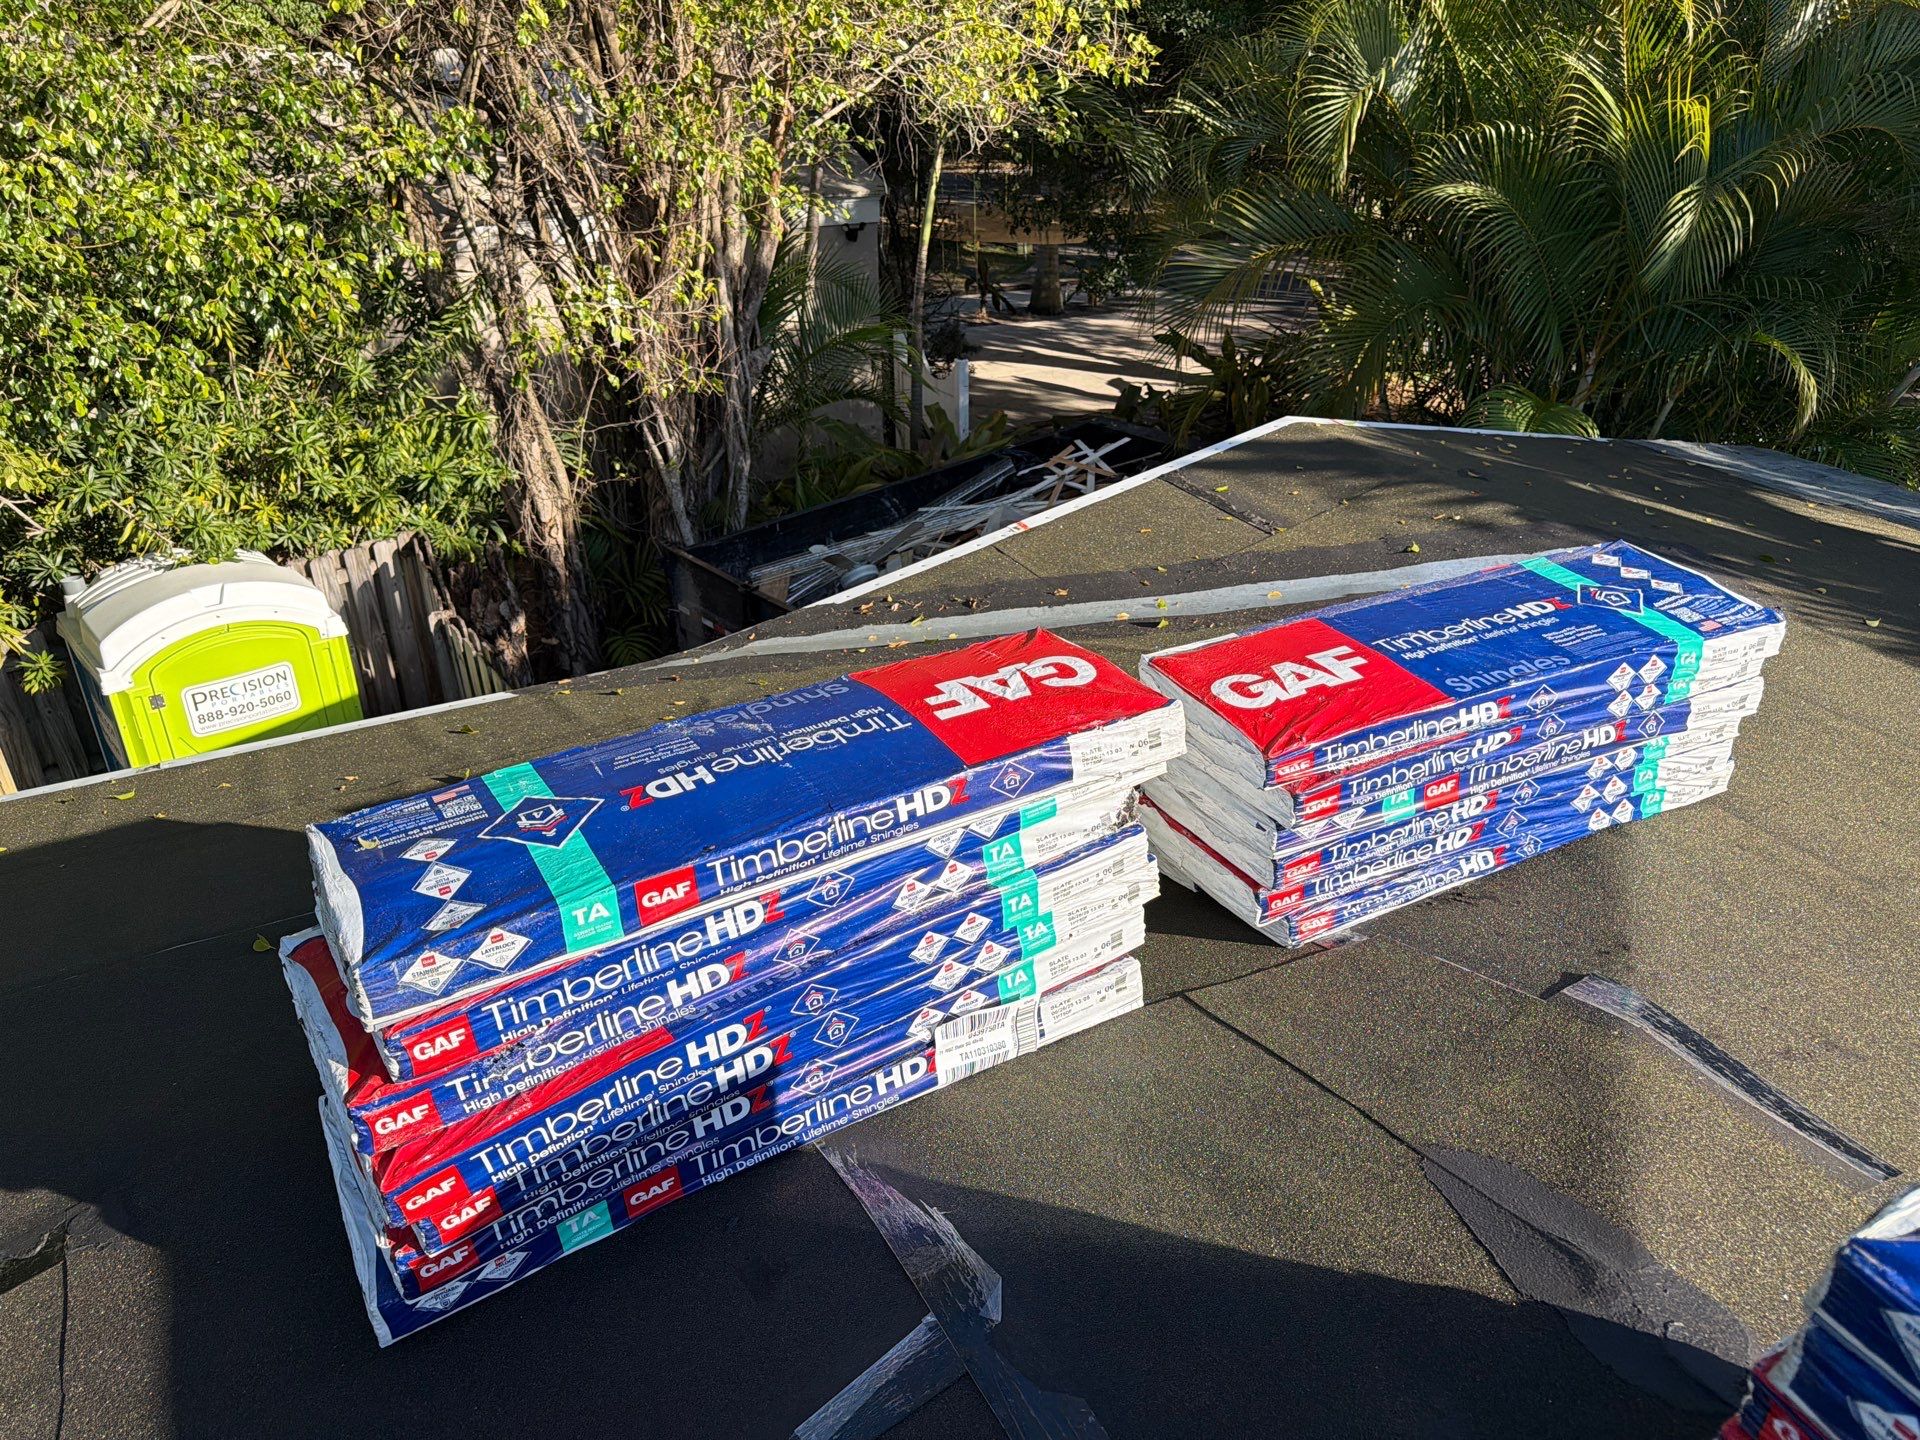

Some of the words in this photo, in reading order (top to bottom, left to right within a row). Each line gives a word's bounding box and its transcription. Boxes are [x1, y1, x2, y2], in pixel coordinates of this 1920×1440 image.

[1372, 611, 1515, 652] Timberline
[1401, 649, 1429, 661] High
[1429, 635, 1477, 654] Definition
[191, 669, 288, 712] PRECISION
[924, 655, 1097, 721] GAF
[1209, 645, 1369, 709] GAF
[1444, 655, 1572, 693] Shingles
[197, 689, 292, 725] 888-920-5060
[211, 681, 290, 708] PORTABLES
[694, 683, 850, 729] Shingles
[782, 715, 850, 739] Definition
[850, 706, 885, 721] High
[711, 712, 913, 772] Timberline
[723, 735, 778, 754] Lifetime
[1322, 716, 1458, 763] Timberline
[1469, 737, 1581, 785] Timberline
[1581, 719, 1627, 751] HDZ
[657, 750, 718, 775] Shingles
[1348, 747, 1470, 799] Timberline
[1469, 781, 1490, 795] High
[1491, 770, 1529, 787] Definition
[1532, 760, 1560, 775] Lifetime
[1561, 750, 1592, 764] Shingles
[617, 764, 717, 811] HDZ
[1426, 779, 1457, 798] GAF
[706, 808, 896, 887] Timberline
[896, 777, 971, 816] HDZ
[1329, 810, 1450, 863] Timberline
[1449, 789, 1499, 823] HDZ
[719, 882, 752, 897] High
[755, 858, 816, 886] Definition
[822, 837, 864, 862] Lifetime
[870, 820, 920, 846] Shingles
[989, 841, 1015, 863] TA
[1311, 843, 1433, 895] Timberline
[1435, 818, 1486, 855] HDZ
[641, 880, 692, 908] GAF
[1007, 892, 1033, 913] TA
[1270, 892, 1300, 910] GAF
[571, 902, 611, 926] TA
[1023, 921, 1049, 940] TA
[480, 940, 516, 956] LAYERLOCK
[481, 929, 703, 1032] Timberline
[704, 892, 785, 948] HDZ
[1048, 954, 1070, 968] SLATE
[1100, 940, 1111, 950] 06
[667, 950, 750, 1008] HDZ
[1003, 969, 1029, 989] TA
[1104, 984, 1115, 993] 06
[541, 993, 614, 1028] Definition
[621, 968, 674, 995] Lifetime
[1050, 997, 1072, 1011] SLATE
[412, 1027, 467, 1062] GAF
[463, 1093, 501, 1115] High
[504, 1059, 576, 1098] Definition
[469, 1055, 683, 1176] Timberline
[686, 1007, 769, 1068] HDZ
[374, 1103, 430, 1136] GAF
[505, 1081, 711, 1192] Timberline
[714, 1033, 794, 1093] HDZ
[688, 1083, 874, 1177] Timberline
[491, 1159, 528, 1184] High
[528, 1126, 595, 1162] Definition
[600, 1093, 653, 1125] Lifetime
[700, 1168, 735, 1188] High
[735, 1138, 797, 1177] Definition
[802, 1113, 849, 1144] Lifetime
[851, 1092, 901, 1120] Shingles
[493, 1129, 689, 1244] Timberline
[693, 1086, 772, 1140] HDZ
[561, 1146, 627, 1182] Definition
[405, 1176, 458, 1211] GAF
[499, 1229, 532, 1250] High
[666, 1134, 721, 1167] Shingles
[629, 1176, 676, 1207] GAF
[440, 1195, 492, 1231] GAF
[564, 1210, 602, 1234] TA
[419, 1246, 469, 1279] GAF
